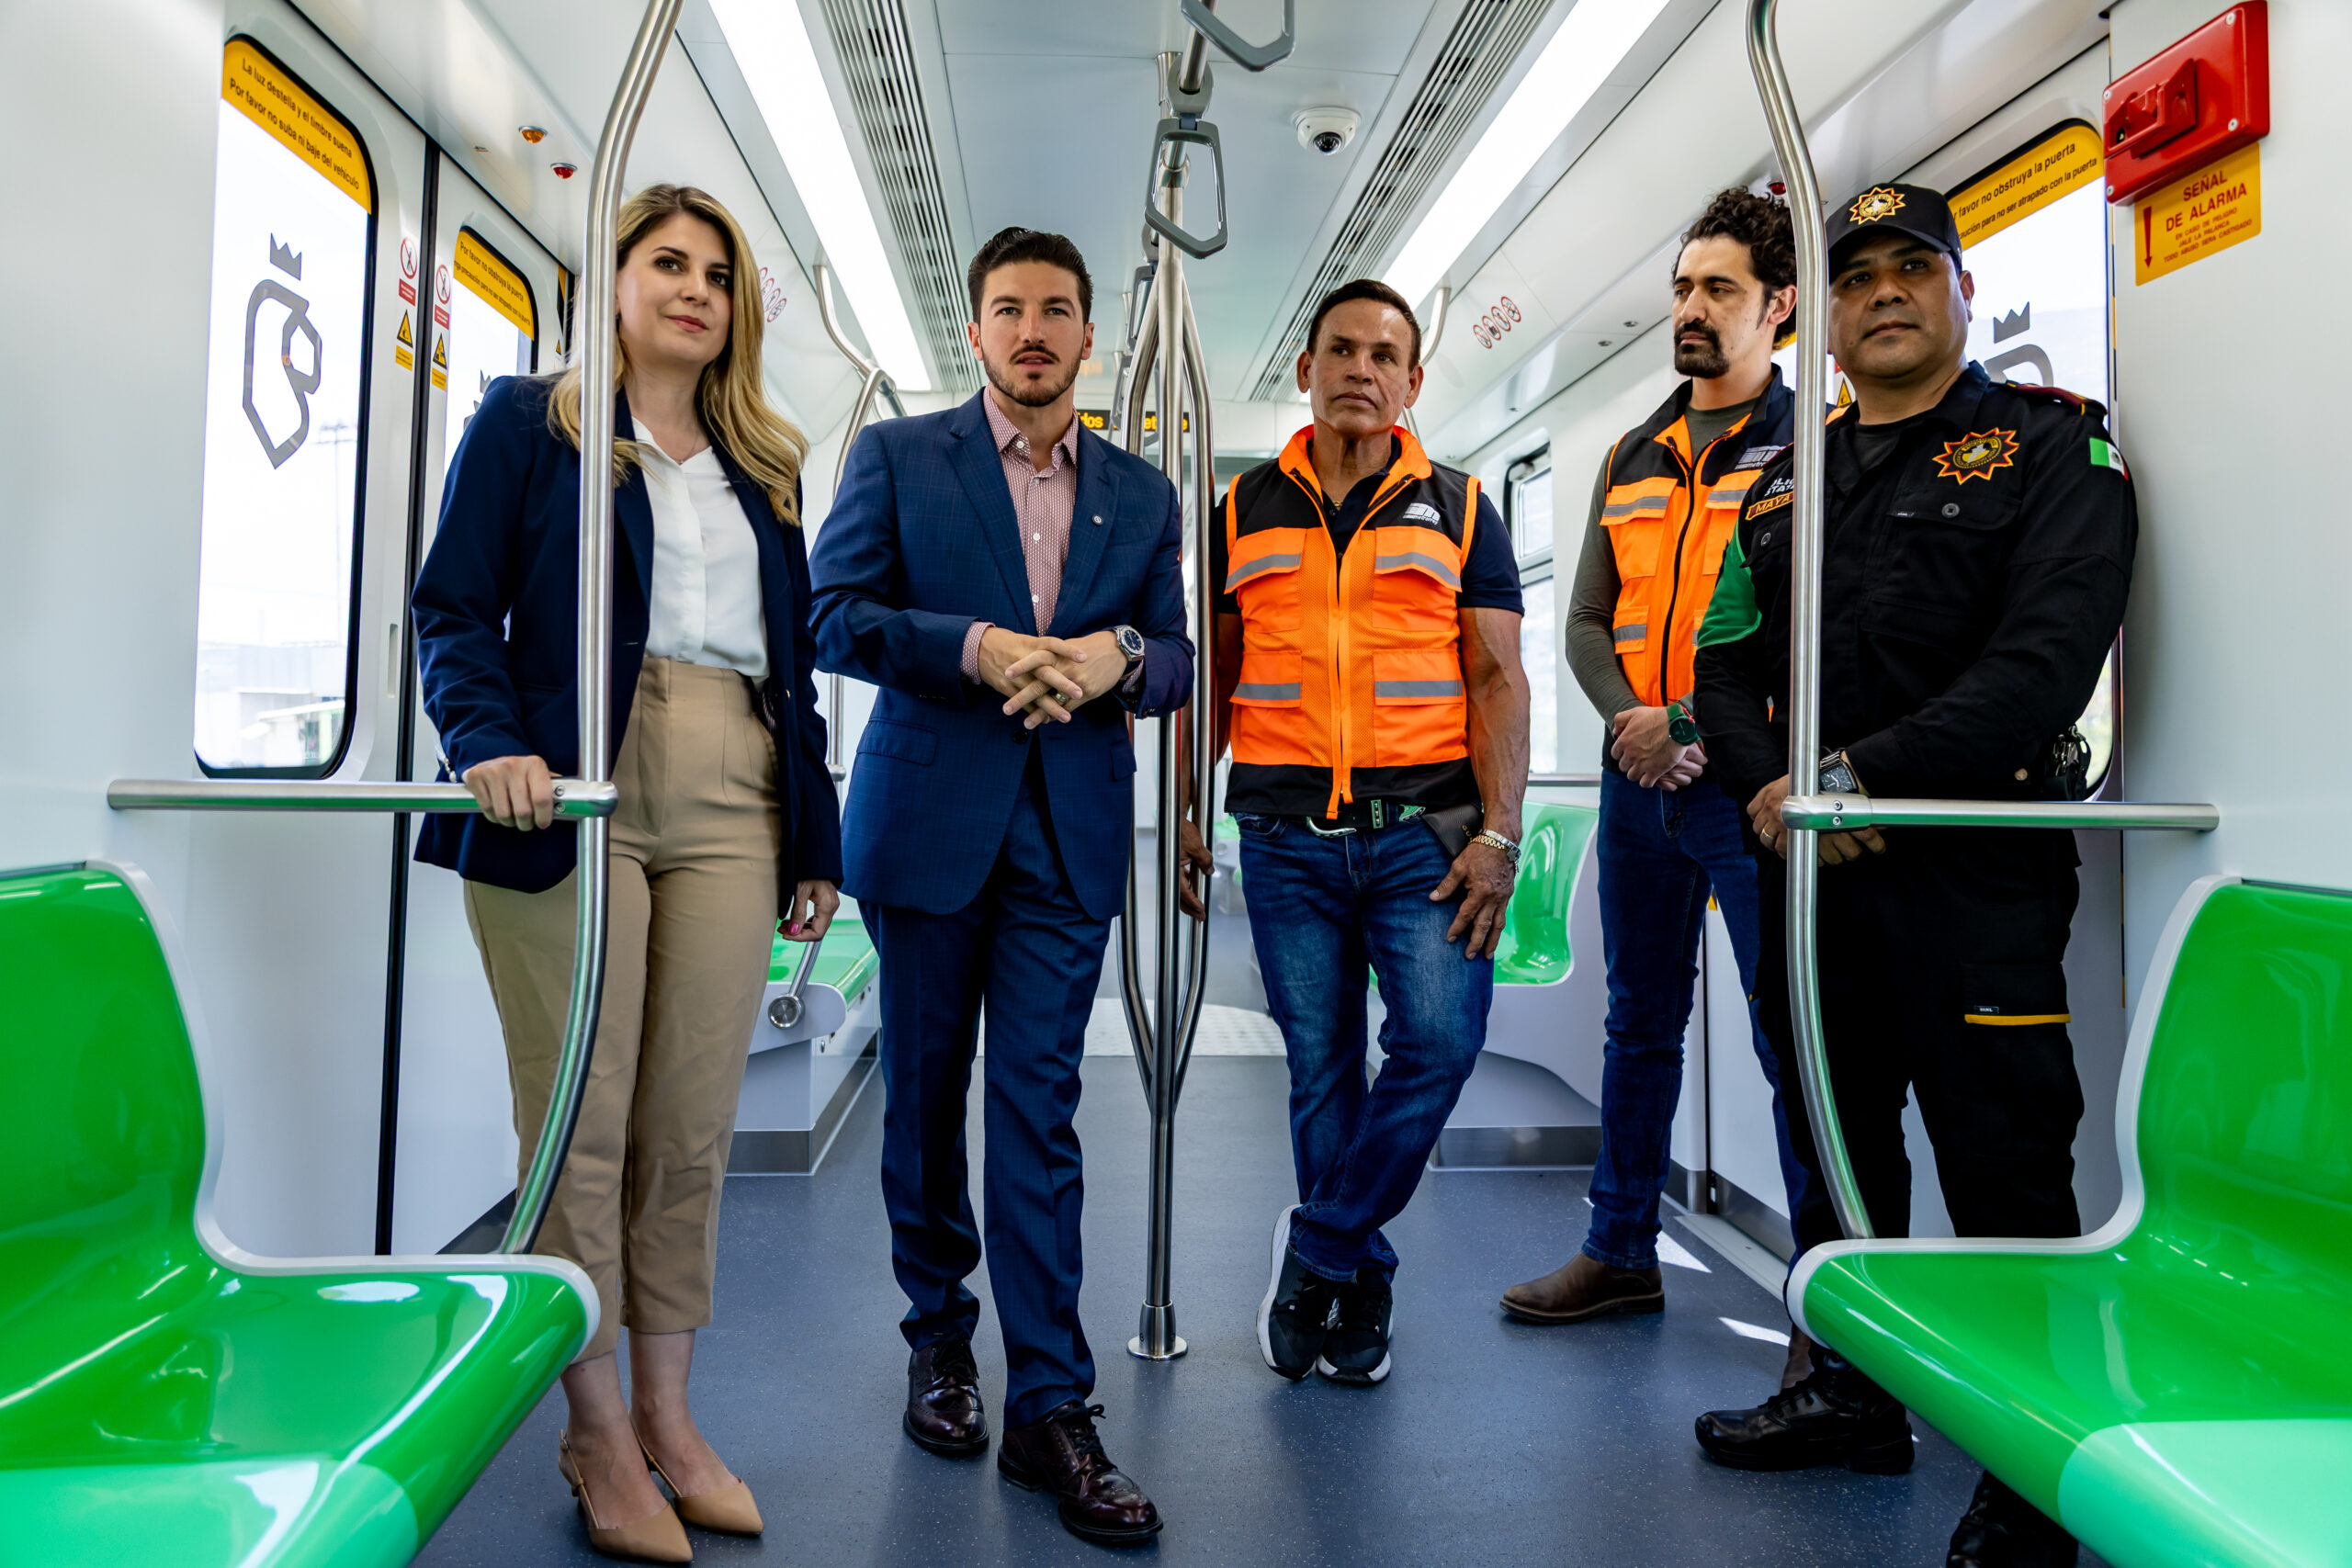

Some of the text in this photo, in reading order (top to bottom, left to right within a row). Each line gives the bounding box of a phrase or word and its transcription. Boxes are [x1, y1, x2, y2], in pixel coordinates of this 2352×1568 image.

[230, 77, 244, 97] Por
[245, 91, 266, 116] favor
[267, 110, 277, 125] no
[278, 119, 297, 140] suba
[298, 134, 305, 147] ni
[306, 139, 321, 159] baje
[322, 153, 333, 168] del
[243, 58, 352, 158] La luz destella y el timbre suena
[1959, 198, 1980, 218] favor
[1981, 192, 1992, 205] no
[1993, 169, 2032, 197] obstruya
[2033, 163, 2043, 175] la
[2044, 143, 2075, 170] puerta
[1996, 208, 2006, 219] no
[2006, 202, 2018, 214] ser
[2050, 176, 2064, 190] con
[2064, 171, 2071, 182] la
[2072, 157, 2098, 179] puerta
[2165, 183, 2247, 232] DE ALARMA
[2183, 170, 2227, 201] SEÑAL
